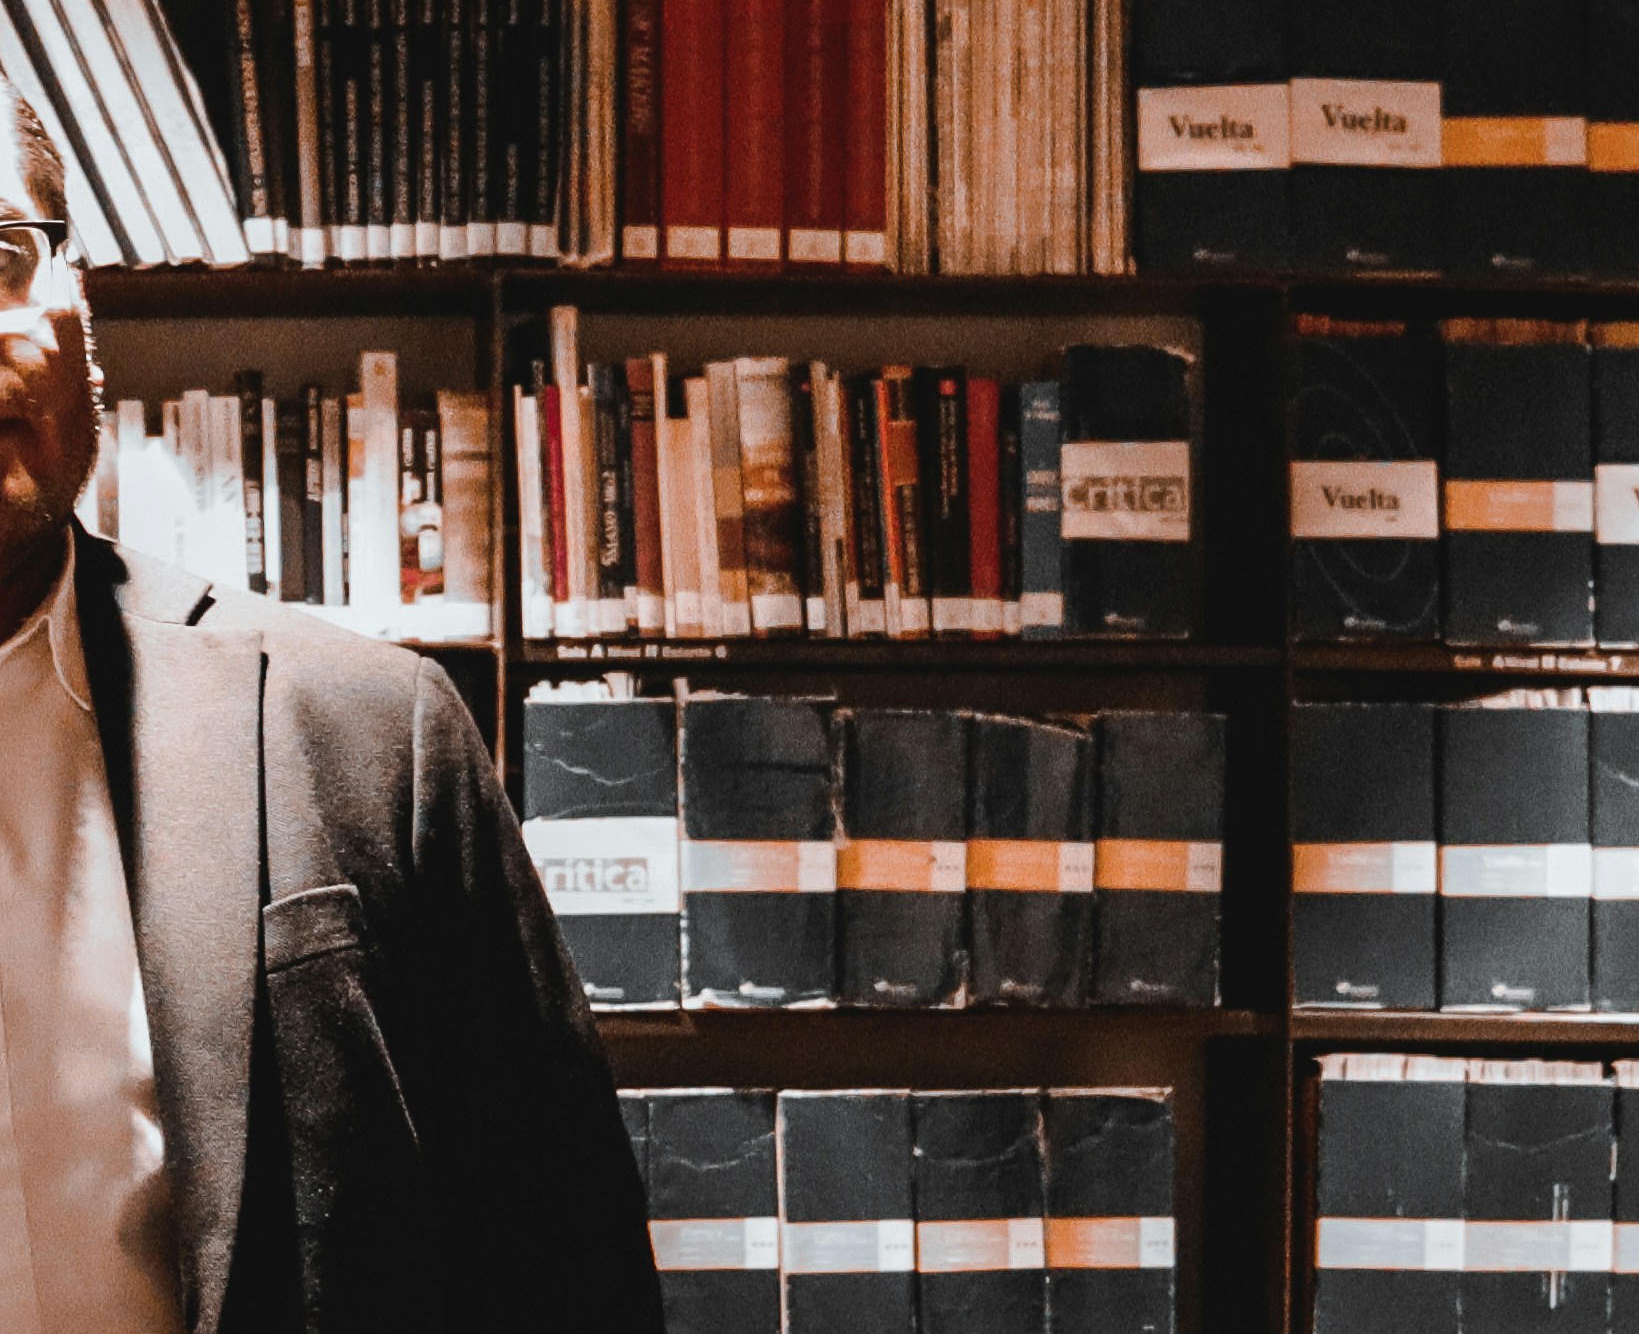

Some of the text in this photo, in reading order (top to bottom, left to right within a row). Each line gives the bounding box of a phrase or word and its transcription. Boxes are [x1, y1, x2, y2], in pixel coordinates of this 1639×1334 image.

[1167, 114, 1254, 140] Vuelta
[1322, 105, 1406, 132] Vuelta
[1322, 487, 1400, 512] Vuelta
[535, 857, 648, 891] rítica
